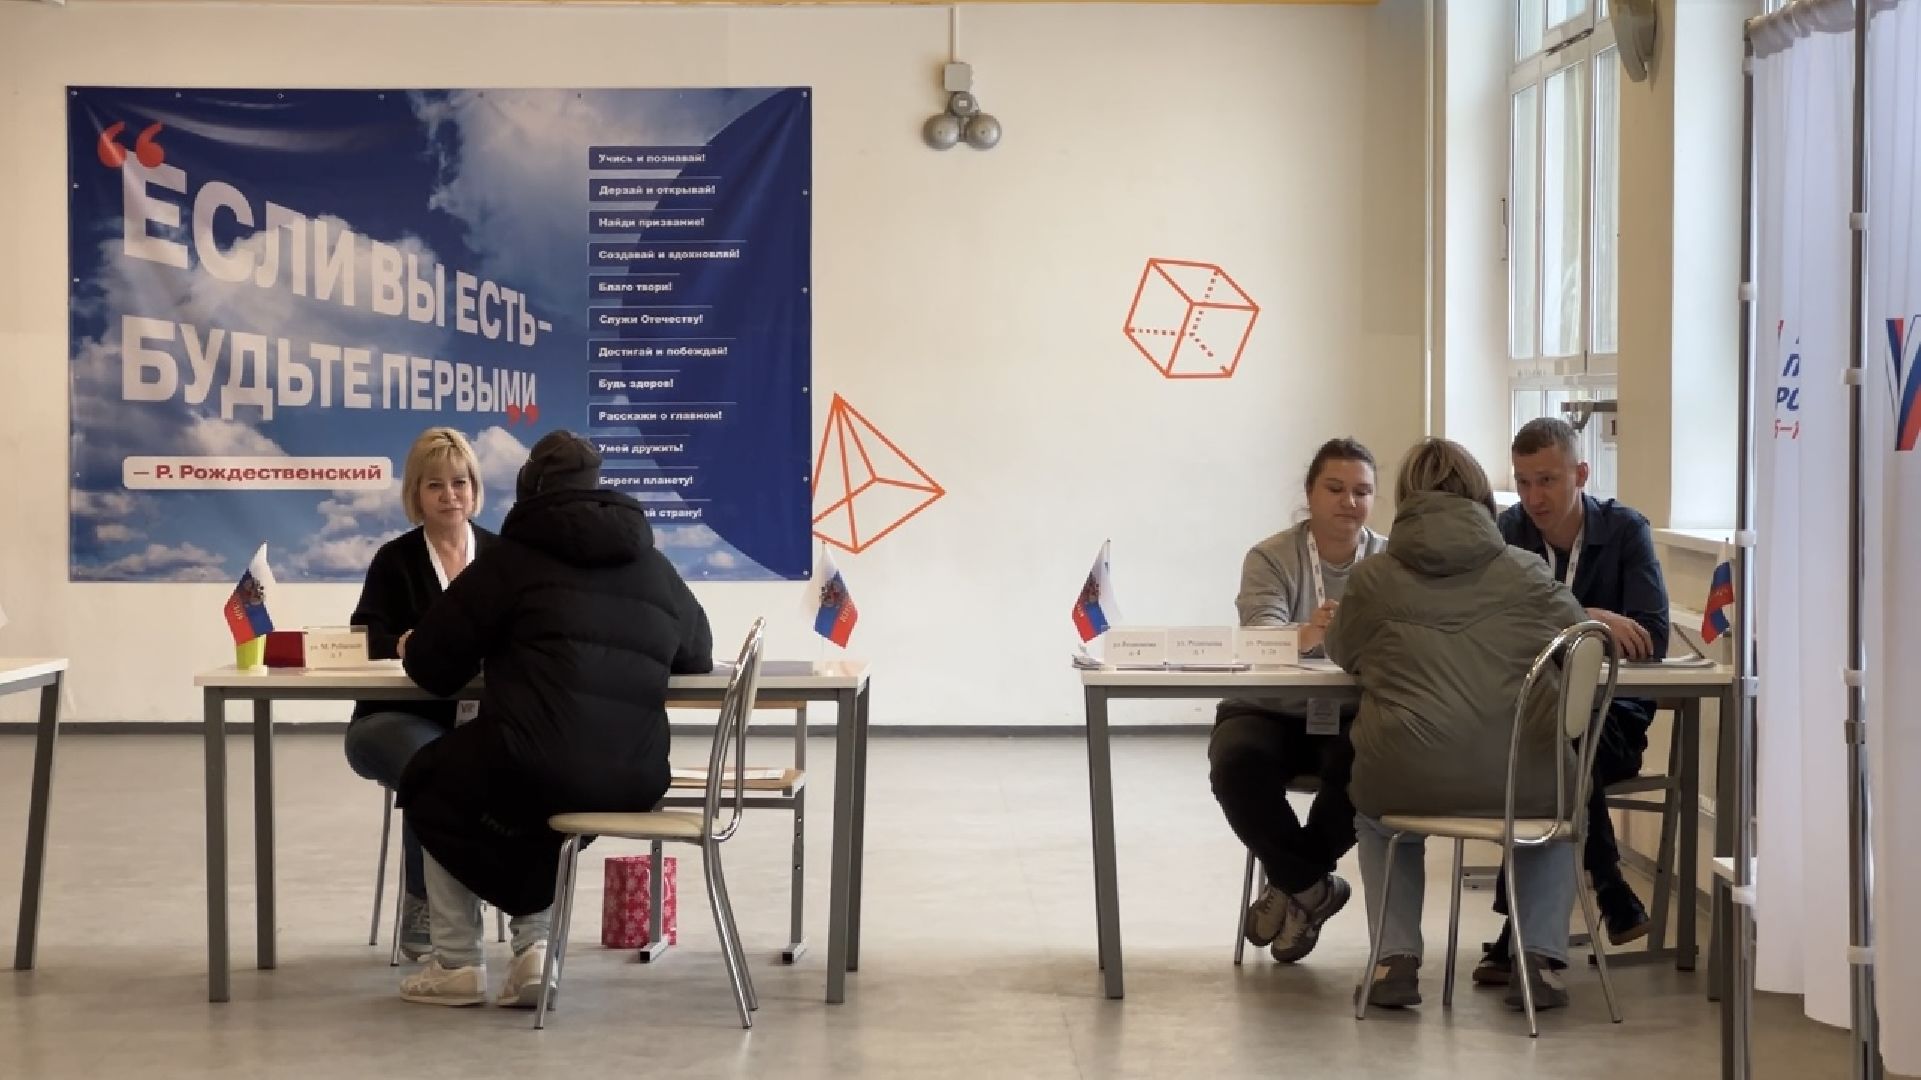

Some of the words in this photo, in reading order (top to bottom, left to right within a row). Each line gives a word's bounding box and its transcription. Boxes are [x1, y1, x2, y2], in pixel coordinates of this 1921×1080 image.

[598, 153, 633, 164] Учись
[646, 153, 706, 164] познавай!
[598, 185, 643, 197] Дерзай
[657, 185, 716, 197] открывай!
[598, 217, 635, 229] Найди
[639, 217, 705, 229] призвание!
[598, 248, 654, 261] Создавай
[668, 248, 740, 261] вдохновляй!
[371, 239, 445, 327] ВЫ
[598, 281, 633, 294] Благо
[636, 281, 672, 294] твори!
[599, 314, 638, 327] Служи
[641, 314, 704, 327] Отечеству!
[598, 346, 652, 358] Достигай
[666, 346, 728, 358] побеждай!
[122, 314, 373, 421] БУДЬТЕ
[598, 378, 627, 391] Будь
[629, 378, 674, 391] здоров!
[598, 411, 657, 422] Расскажи
[670, 411, 722, 422] главном!
[599, 443, 629, 455] Умей
[631, 443, 684, 455] дружить!
[156, 464, 174, 479] Р.
[179, 464, 382, 482] Рождественский
[599, 475, 641, 488] Береги
[643, 475, 694, 488] планету!
[658, 507, 702, 519] страну!
